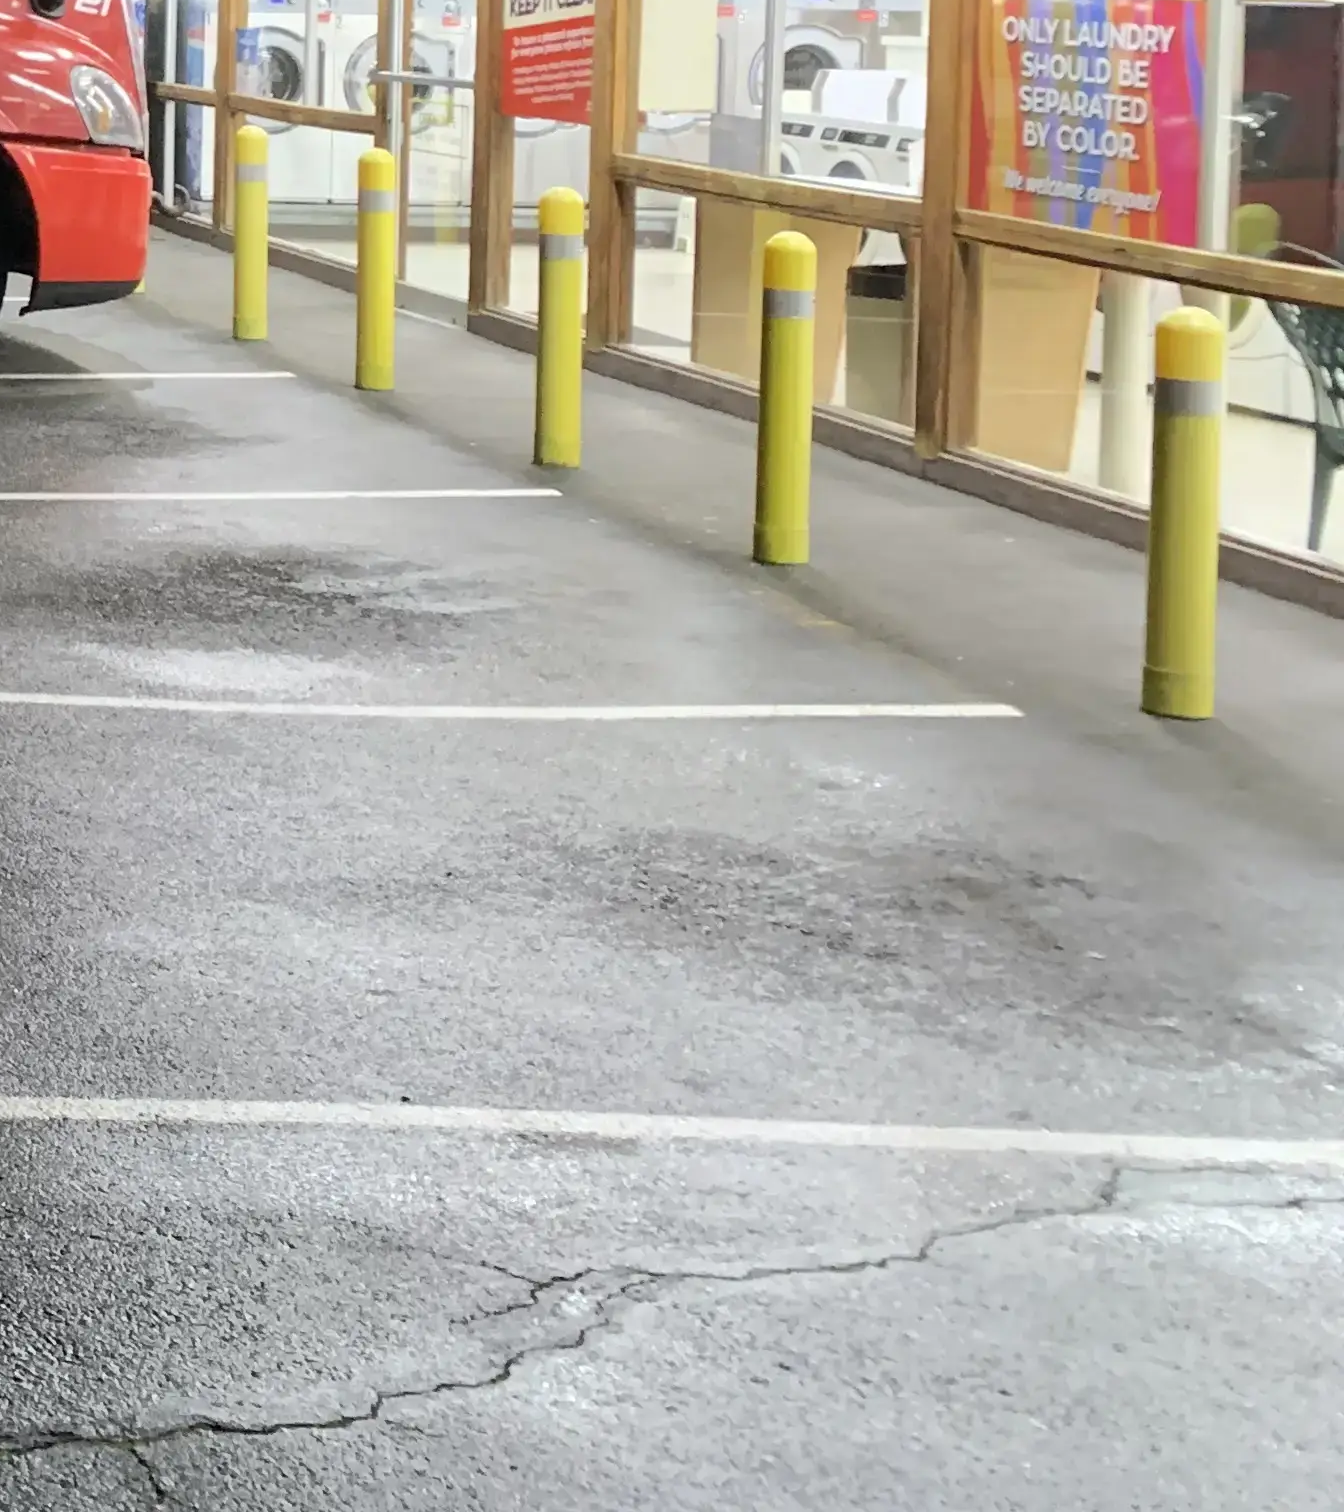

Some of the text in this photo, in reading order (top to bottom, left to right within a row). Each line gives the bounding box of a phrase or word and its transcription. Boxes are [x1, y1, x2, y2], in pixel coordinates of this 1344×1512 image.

[1002, 15, 1176, 53] ONLY LAUNDRY
[1020, 51, 1150, 88] SHOULD BE
[1018, 85, 1148, 124] SEPARATED
[1022, 120, 1140, 161] BY COLOR.
[1025, 175, 1085, 201] welcome
[1085, 186, 1163, 215] everyone!
